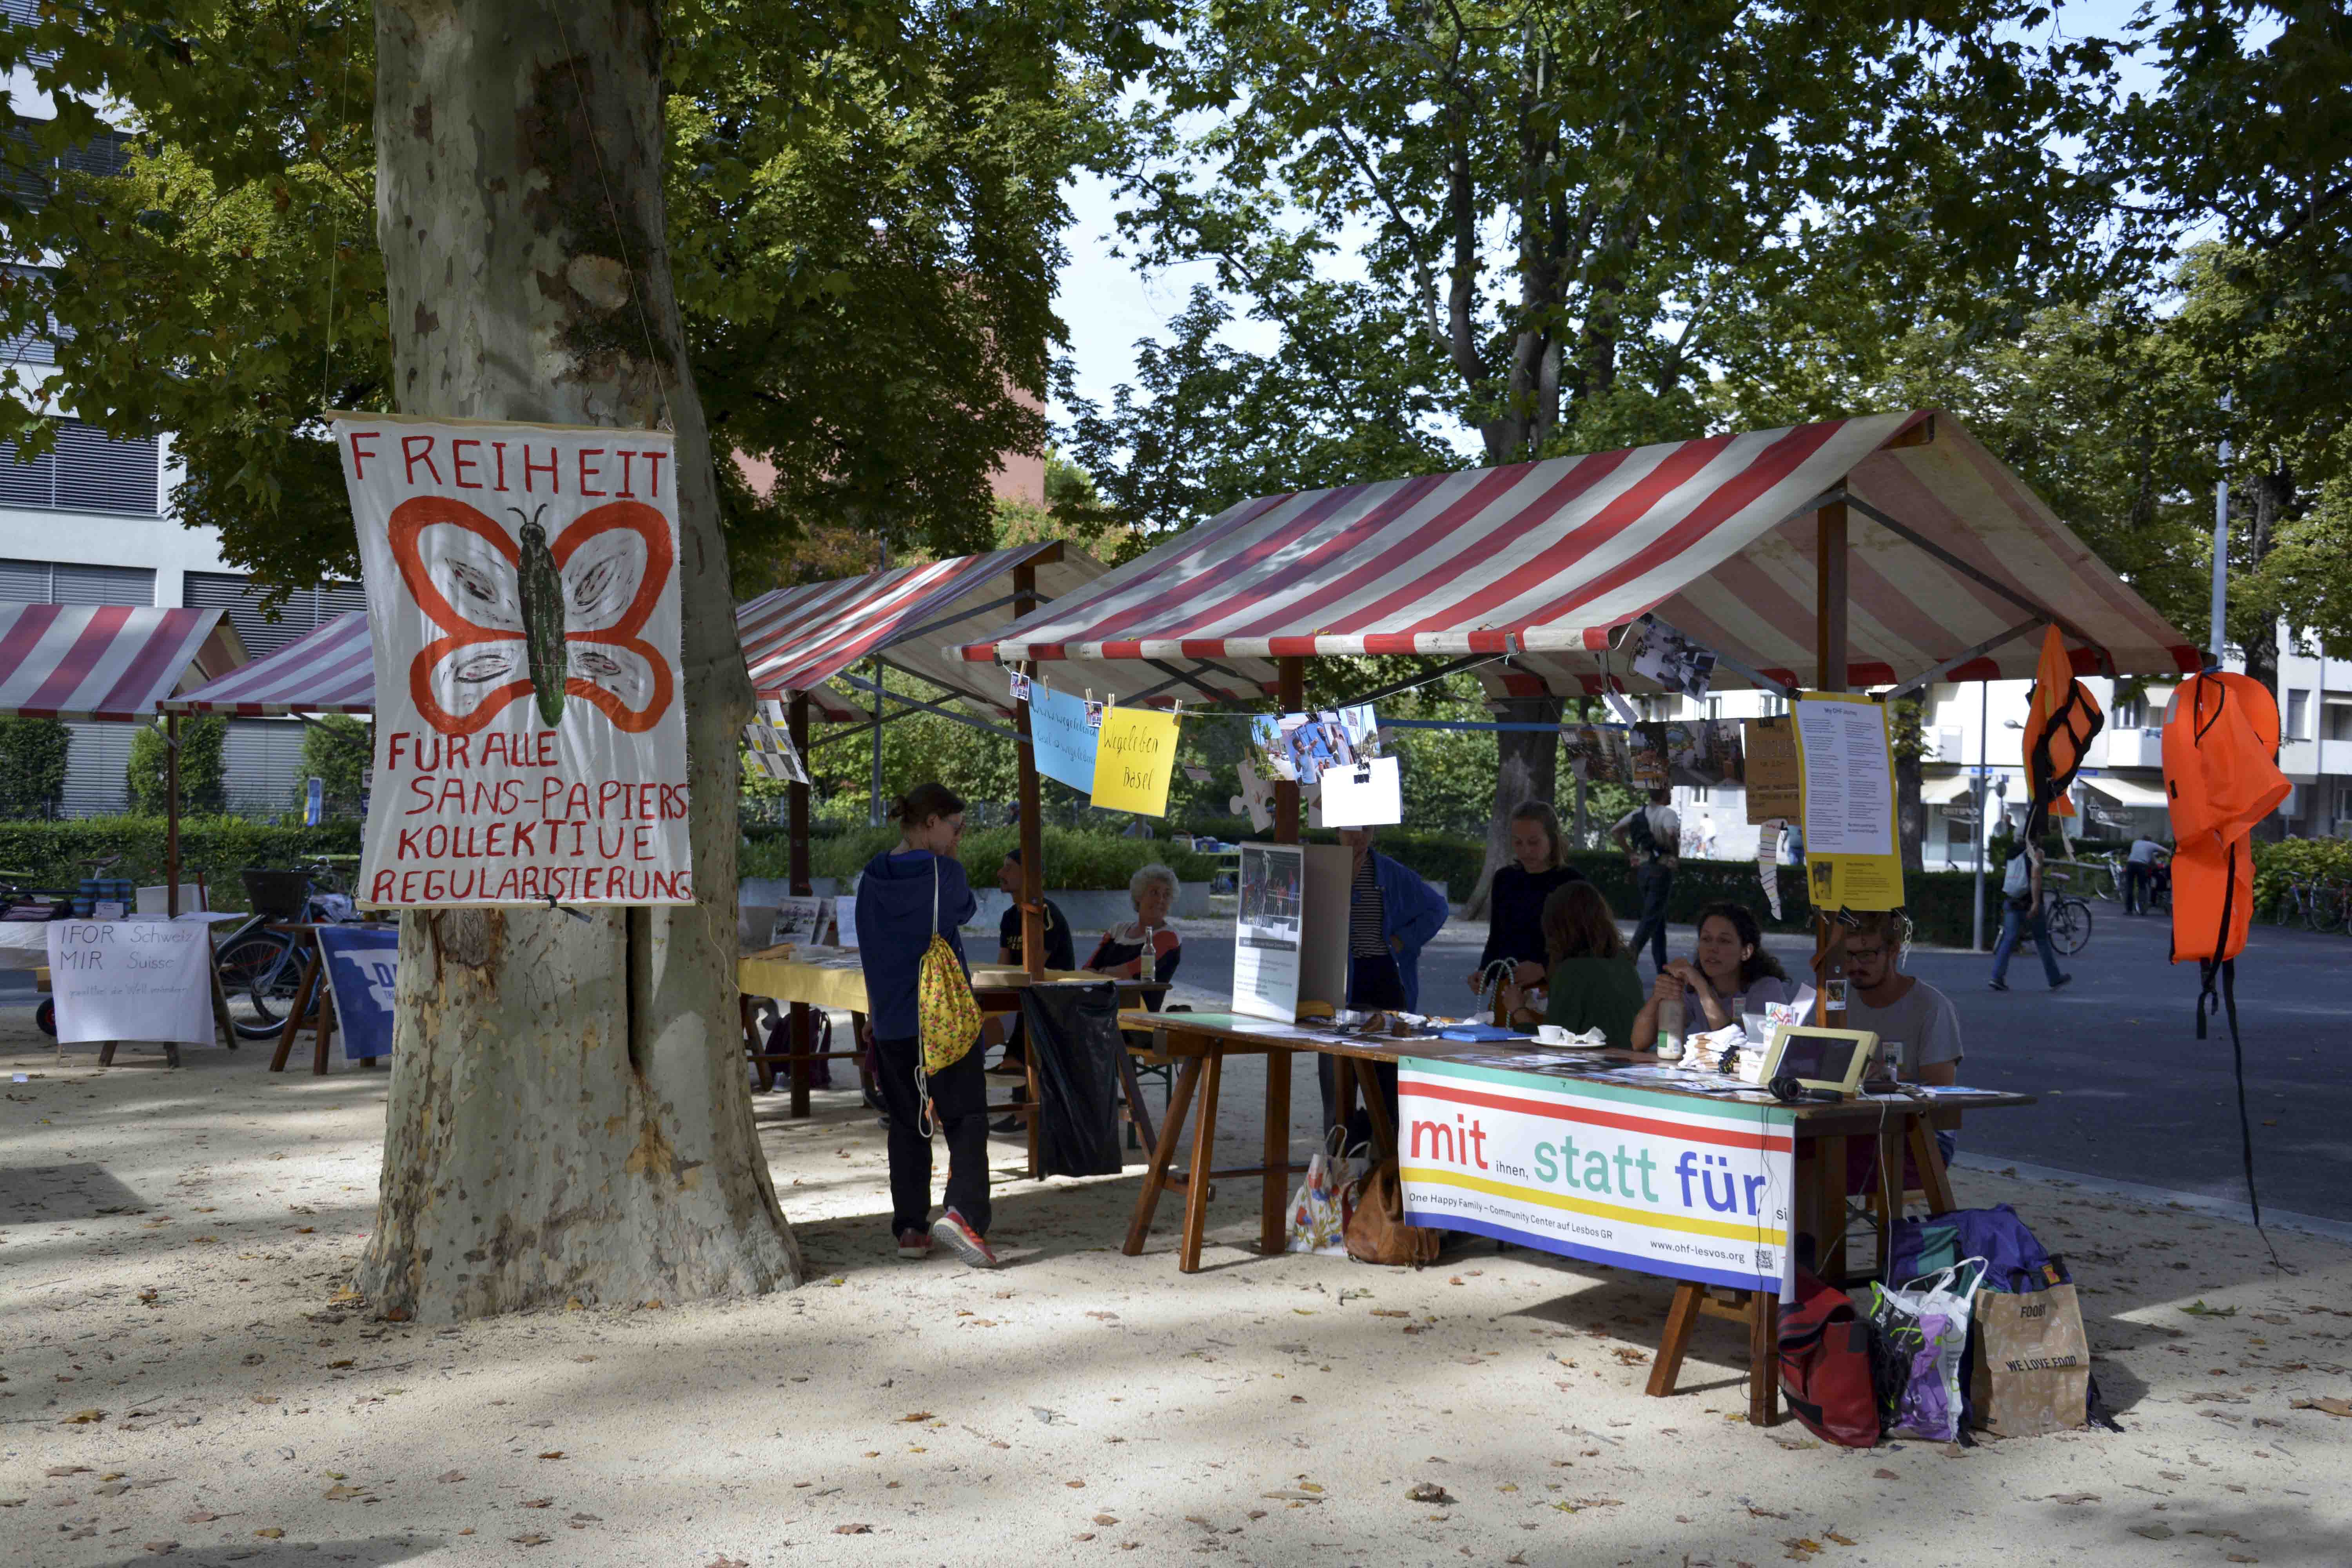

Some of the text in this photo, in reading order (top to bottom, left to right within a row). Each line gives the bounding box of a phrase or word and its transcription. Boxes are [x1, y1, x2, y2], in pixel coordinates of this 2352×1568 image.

[350, 432, 668, 498] FREIHEIT
[388, 731, 558, 772] FÜR ALLE
[1123, 766, 1154, 790] Basel
[405, 775, 688, 820] SANS-PAPIERS
[370, 865, 691, 903] REGULARISIERUNG
[61, 925, 194, 944] IFOR Schweiz
[60, 950, 175, 970] MIR Suisse
[1410, 1113, 1488, 1170] mit
[1496, 1160, 1529, 1180] ihnen,
[1534, 1135, 1659, 1203] statt
[1675, 1151, 1766, 1216] für
[1409, 1192, 1428, 1202] One
[1430, 1195, 1457, 1207] Happy
[1459, 1198, 1483, 1212] Family
[1490, 1205, 1530, 1224] Community
[1530, 1215, 1555, 1228] Center
[1557, 1222, 1570, 1231] auf
[1572, 1223, 1600, 1237] Lesbos
[1601, 1231, 1613, 1240] GR
[1650, 1240, 1745, 1264] www.ohf-lesvos.org
[2005, 1355, 2076, 1372] WE LOVE FOOD
